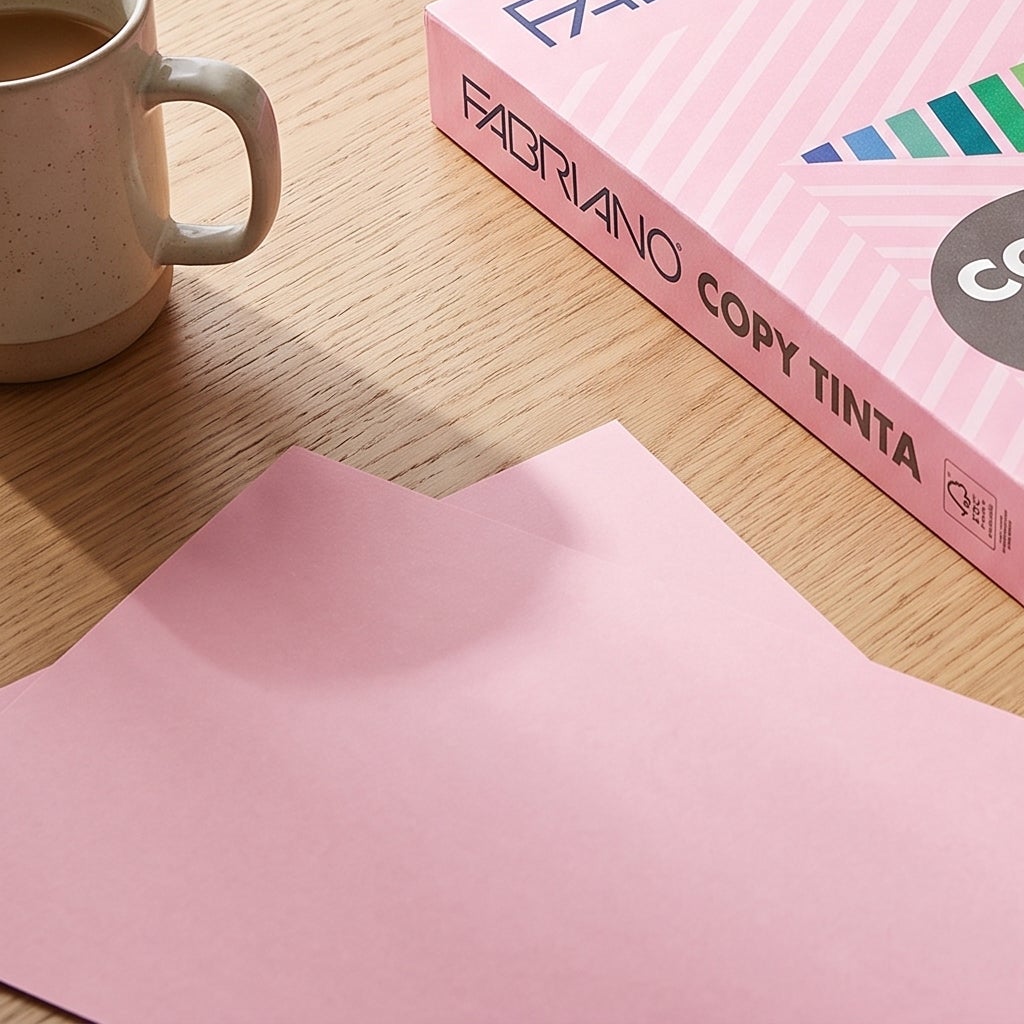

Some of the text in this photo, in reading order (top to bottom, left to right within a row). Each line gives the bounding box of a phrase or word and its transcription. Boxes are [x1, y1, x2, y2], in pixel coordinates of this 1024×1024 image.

[461, 72, 922, 484] FABRIANO COPY TINTA
